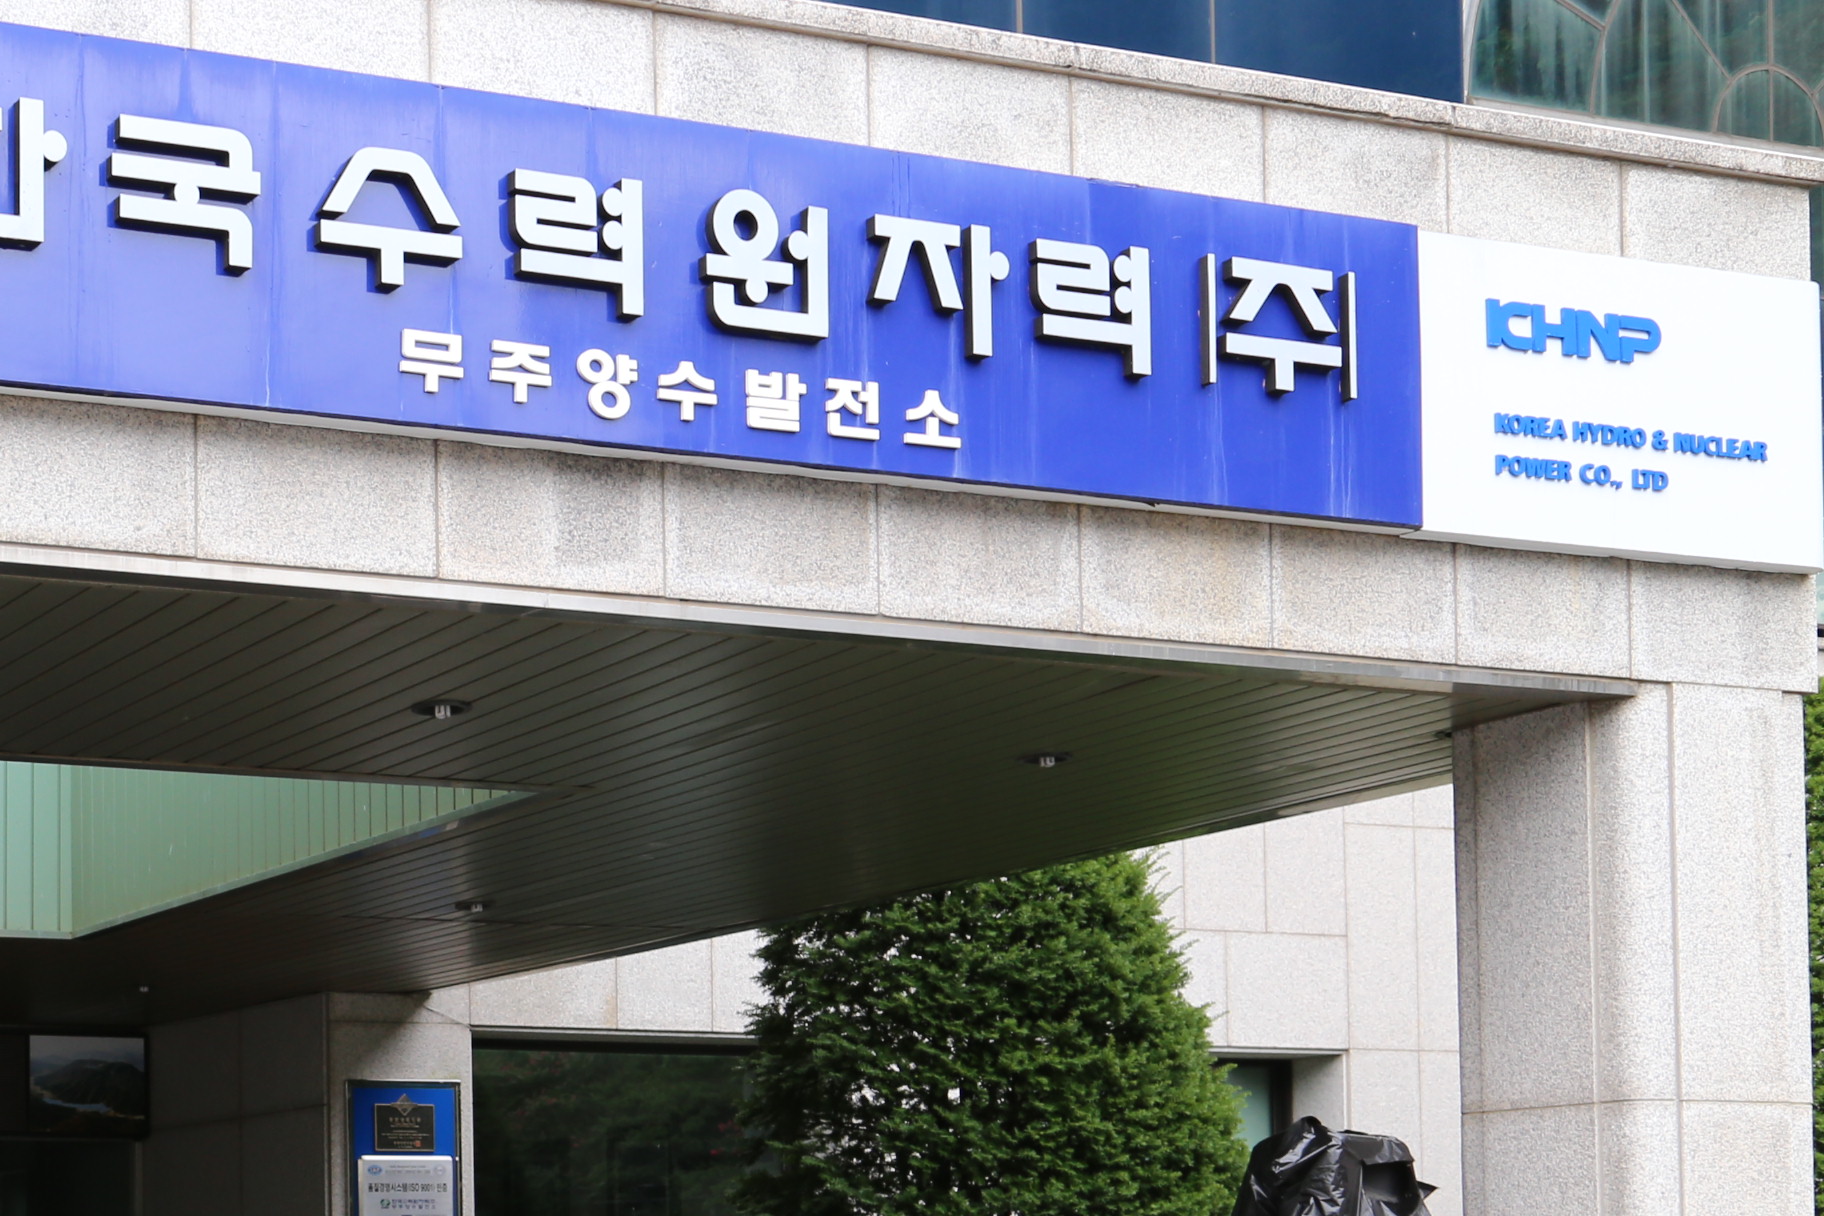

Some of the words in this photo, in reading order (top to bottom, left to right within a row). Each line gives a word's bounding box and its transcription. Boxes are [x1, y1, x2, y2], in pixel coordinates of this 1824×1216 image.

[1485, 298, 1662, 363] KHNP
[399, 328, 962, 449] 무주양수발전소
[1494, 412, 1567, 441] KOREA
[1572, 421, 1647, 450] HYDRO
[1652, 430, 1668, 451] &
[1673, 432, 1768, 462] NUCLEAR
[1495, 454, 1572, 483] POWER
[1631, 468, 1669, 492] LTD
